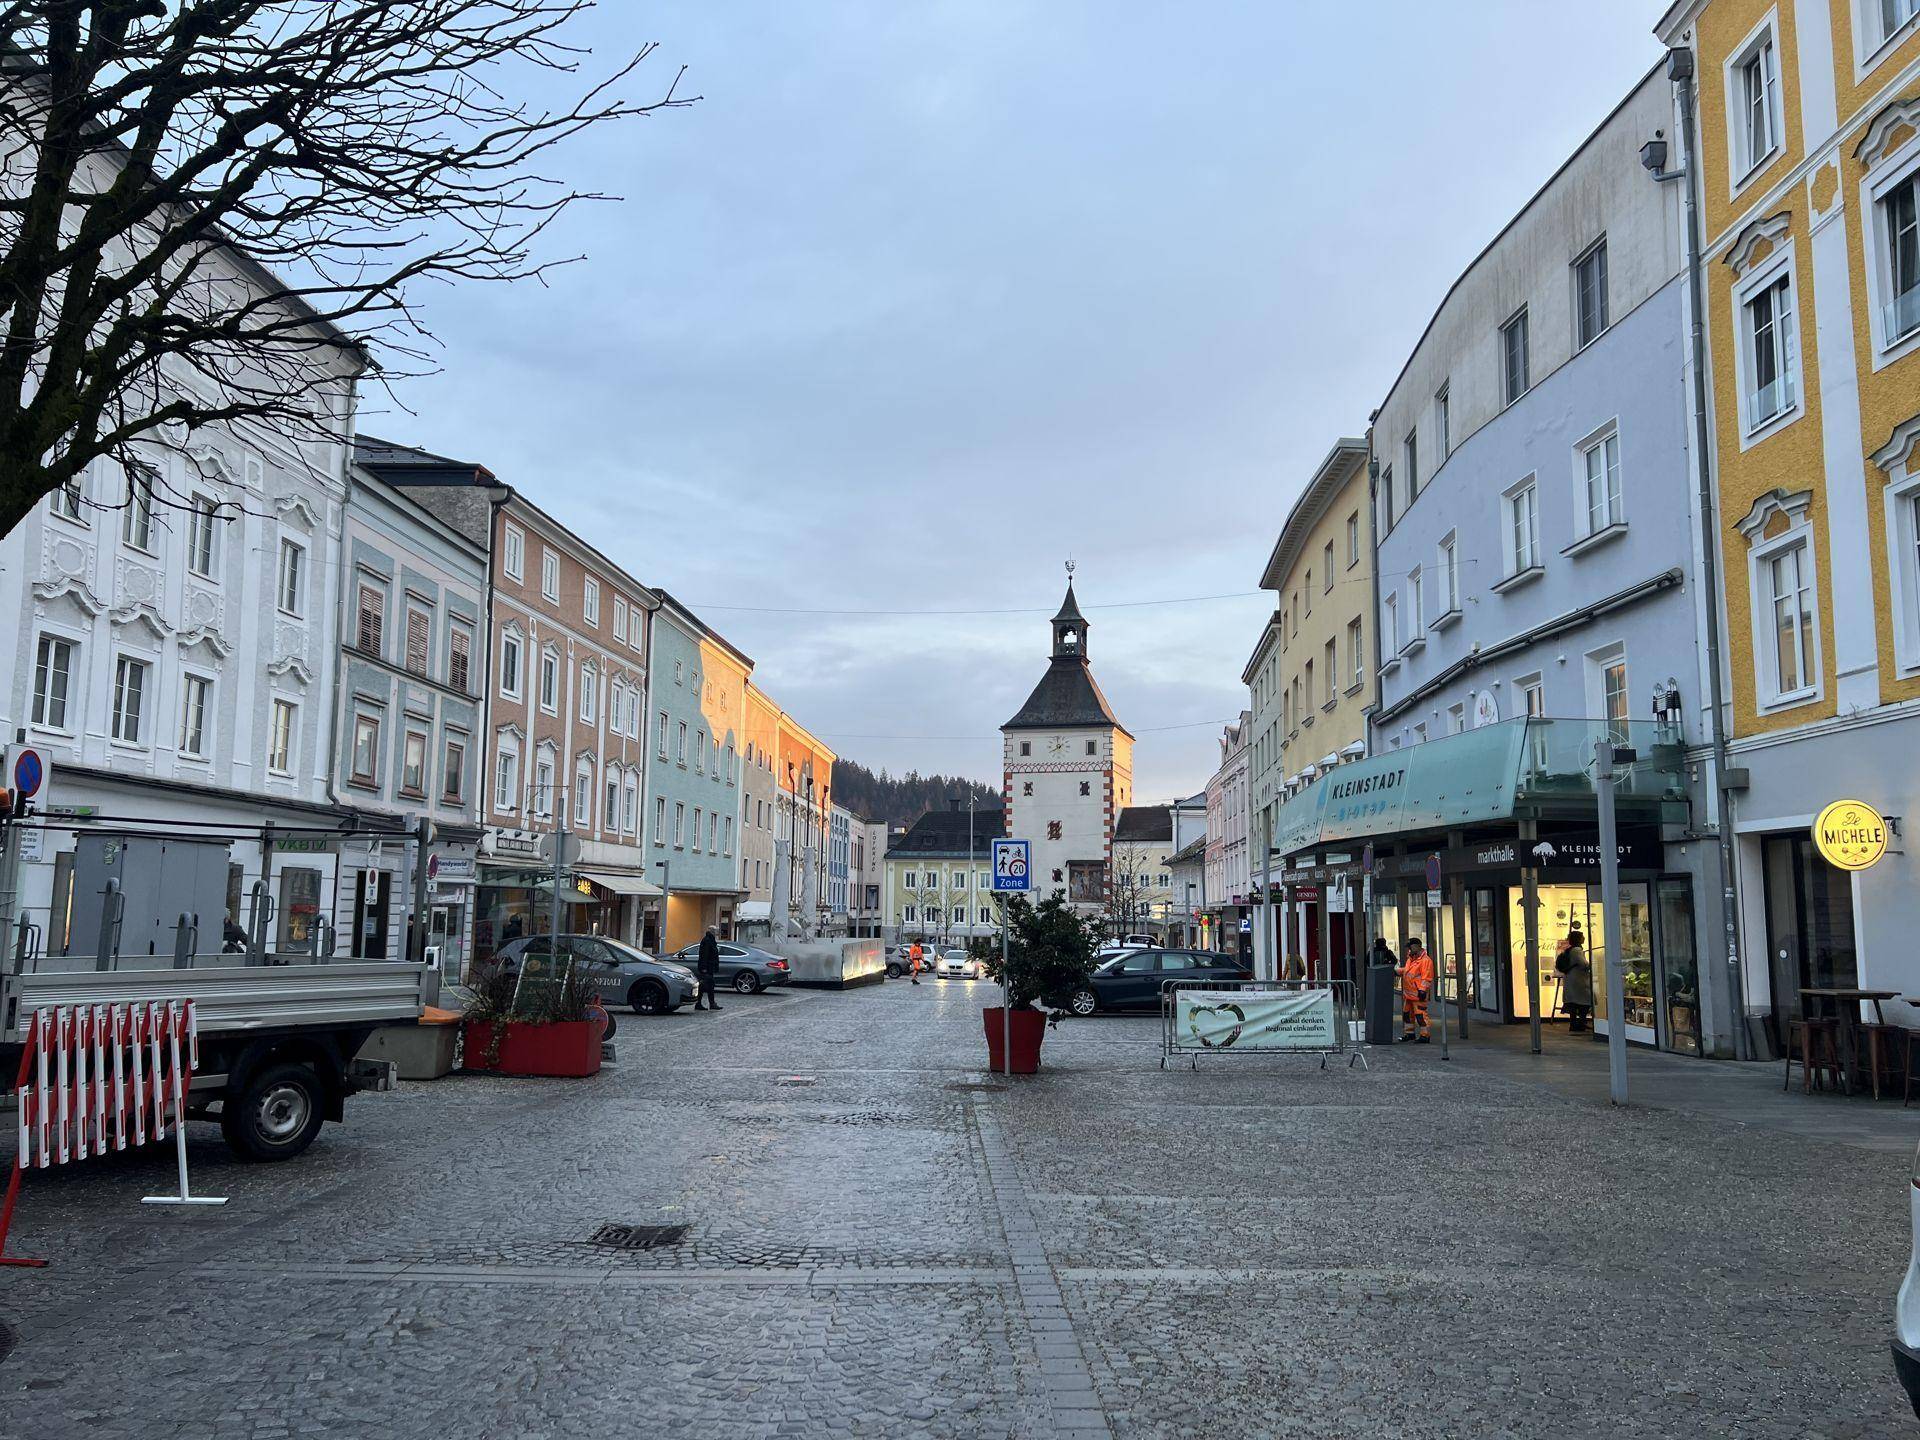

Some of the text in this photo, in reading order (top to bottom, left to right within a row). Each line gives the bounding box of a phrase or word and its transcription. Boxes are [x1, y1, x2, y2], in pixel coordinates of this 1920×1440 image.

[1332, 769, 1405, 800] KLEINSTADT
[1842, 811, 1861, 826] De
[1824, 828, 1882, 845] MICHELE
[1477, 845, 1514, 864] markthalle
[1561, 845, 1632, 854] KLEINSDT
[1013, 864, 1024, 874] 20
[1000, 878, 1023, 887] Zone
[1241, 919, 1249, 927] P
